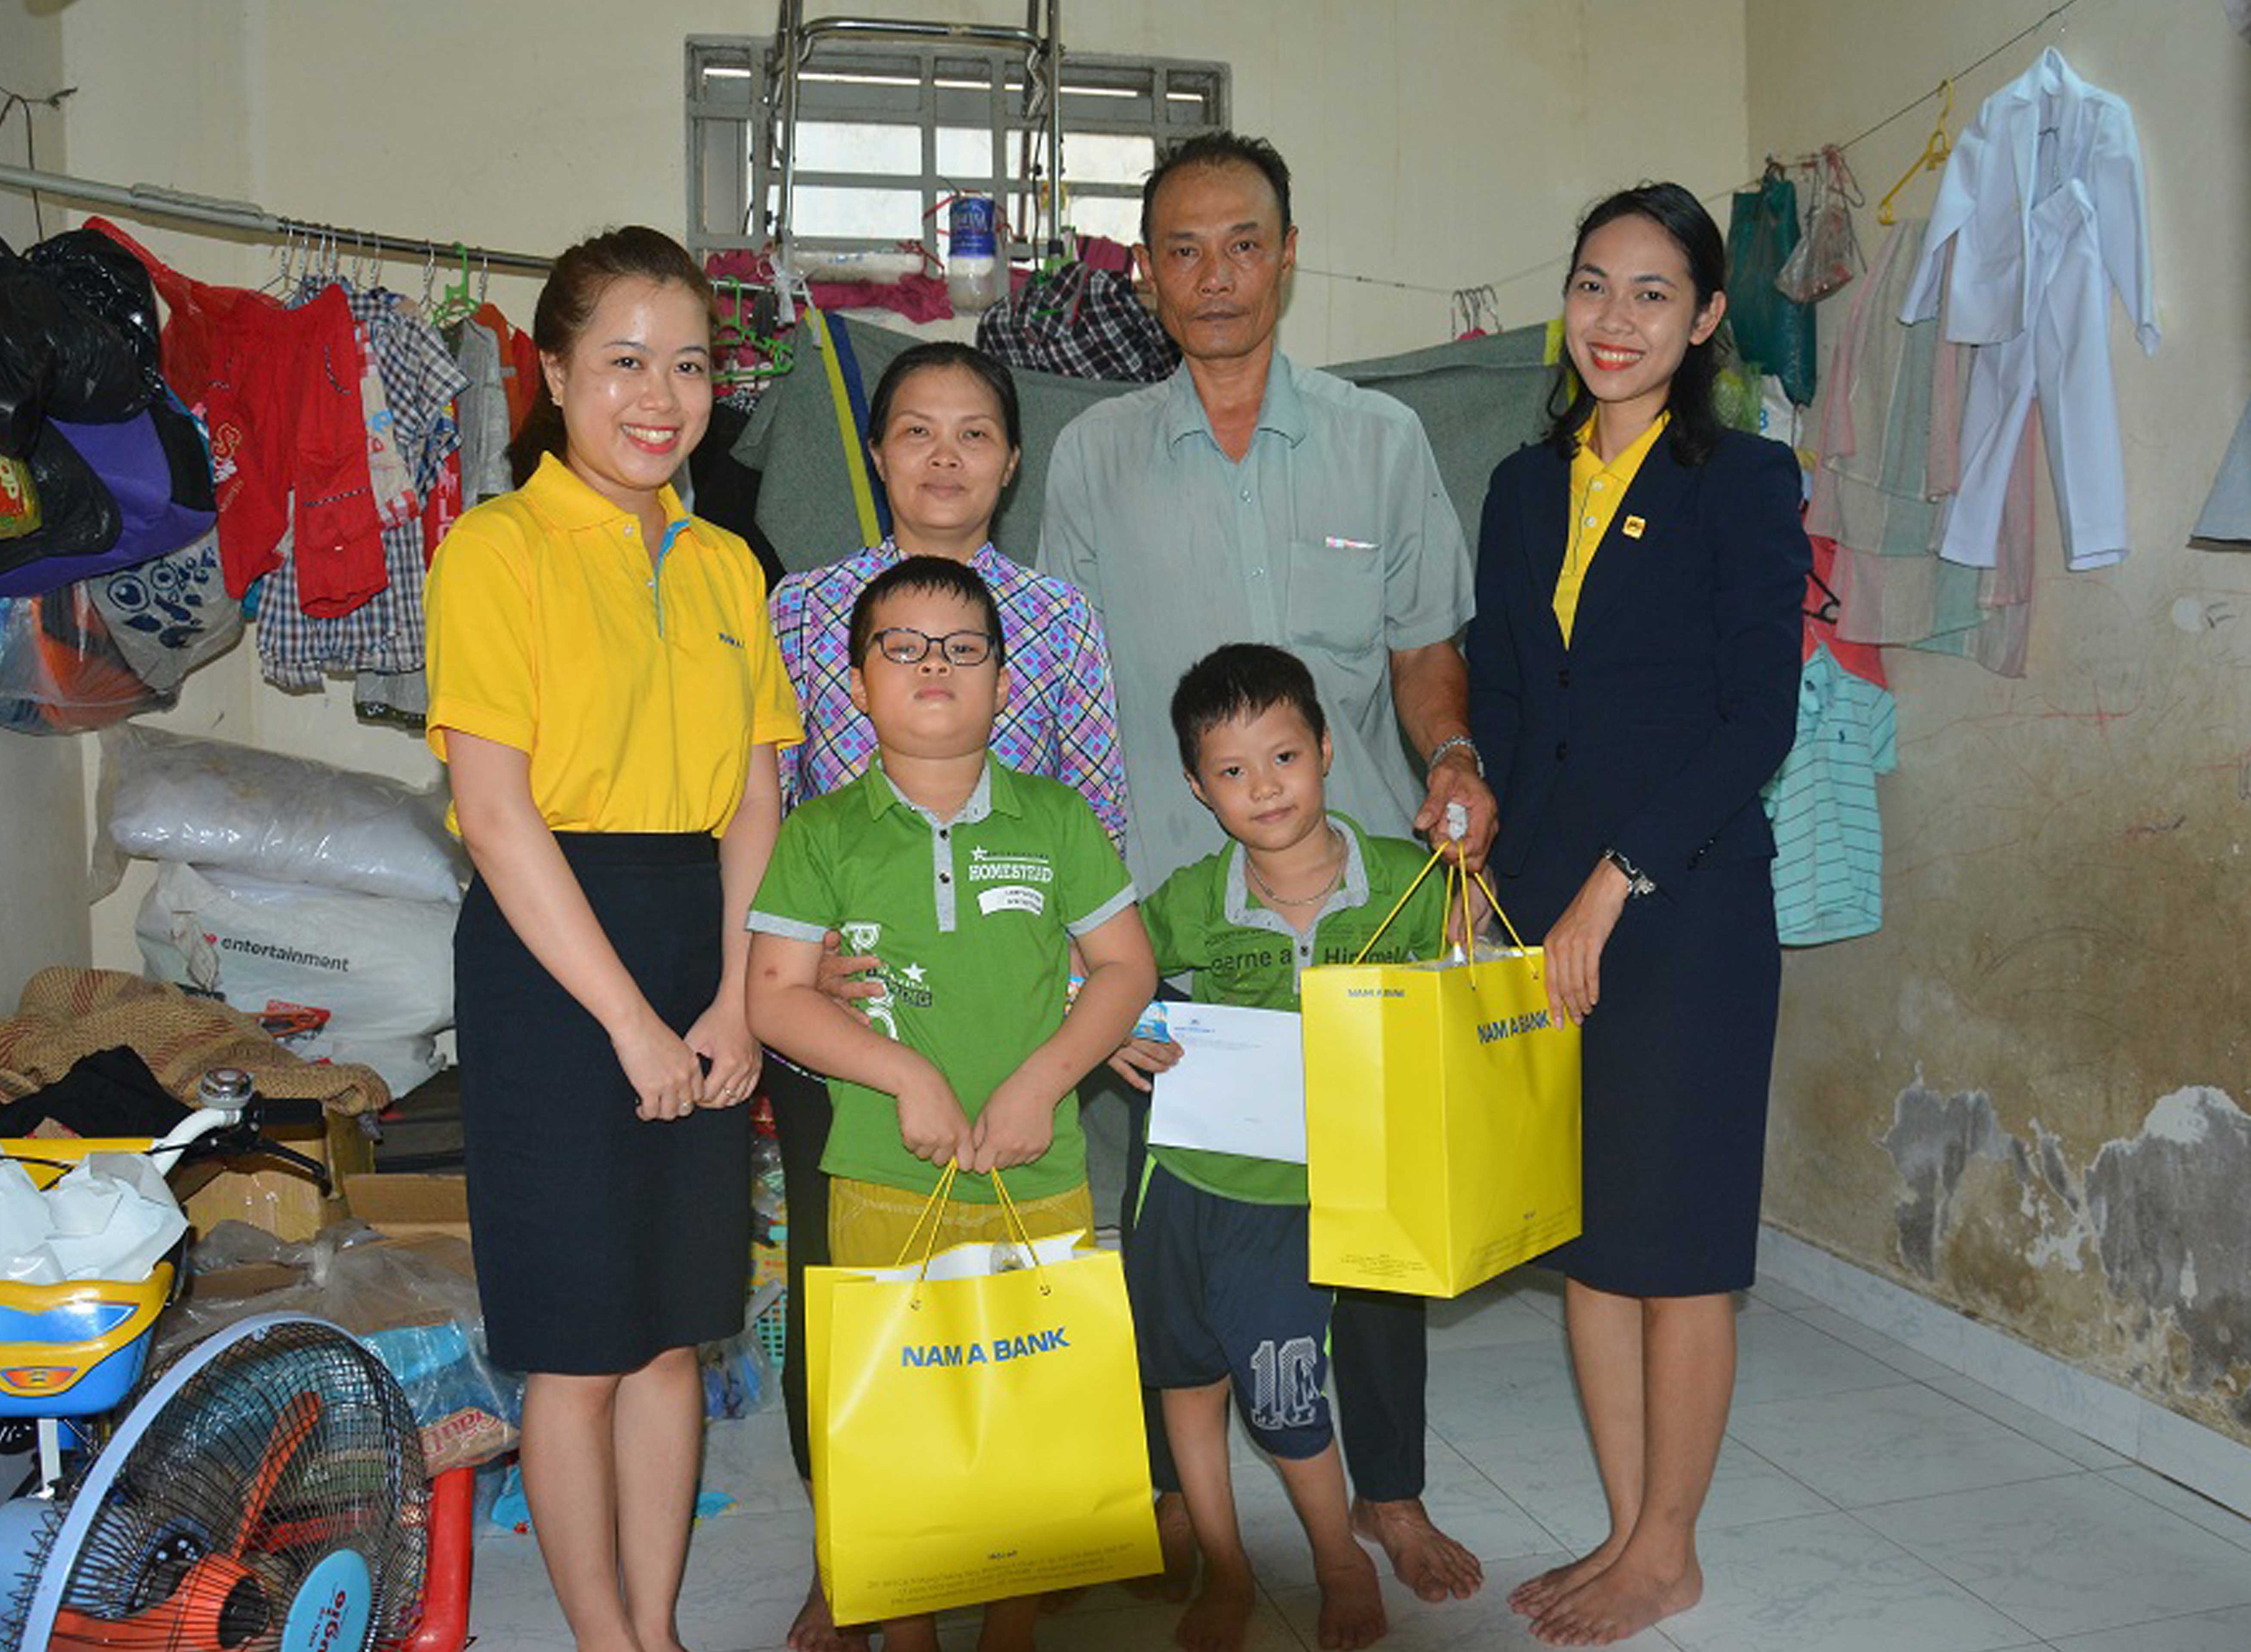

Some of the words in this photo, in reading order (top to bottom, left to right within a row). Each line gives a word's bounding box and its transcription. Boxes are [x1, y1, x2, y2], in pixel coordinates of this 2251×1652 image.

[221, 937, 349, 972] entertainment
[901, 1345, 963, 1367] NAM
[967, 1342, 988, 1365] A
[993, 1325, 1070, 1362] BANK
